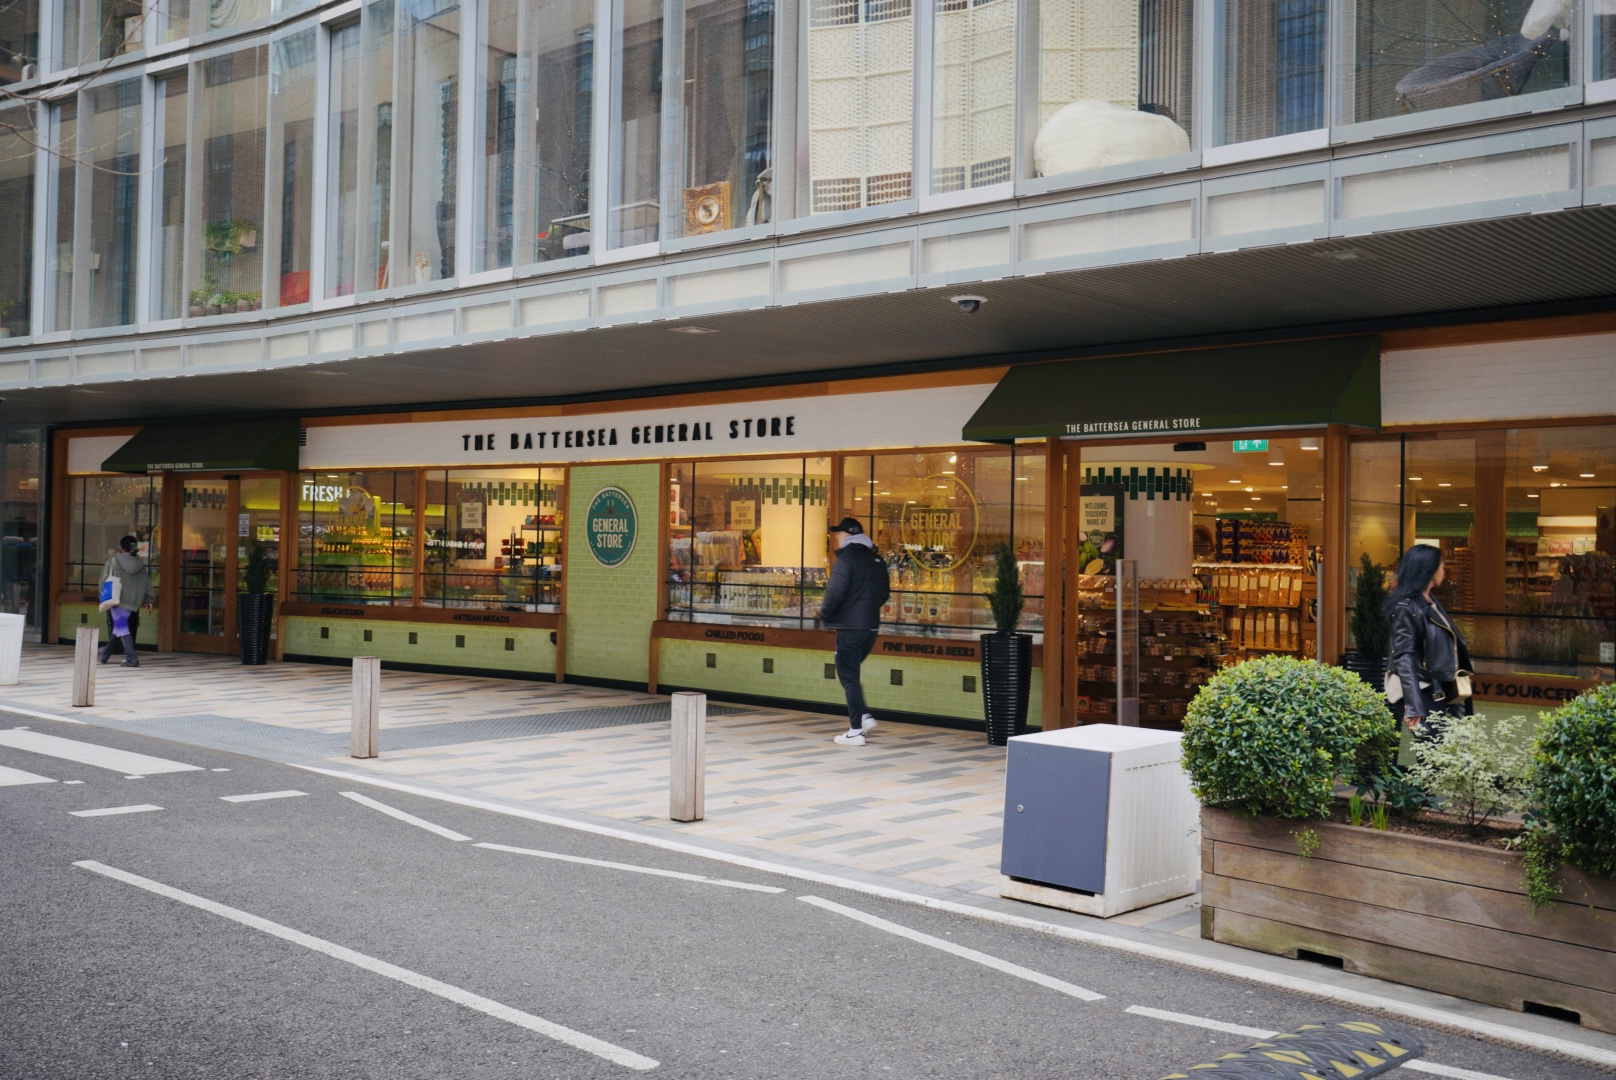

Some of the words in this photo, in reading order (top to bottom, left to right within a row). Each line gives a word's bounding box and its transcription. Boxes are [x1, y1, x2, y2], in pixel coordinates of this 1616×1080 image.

[1066, 424, 1081, 433] THE
[1083, 421, 1129, 433] BATTERSEA
[1131, 419, 1170, 431] GENERAL
[1172, 417, 1201, 429] STORE
[462, 433, 496, 452] THE
[510, 428, 618, 450] BATTERSEA
[631, 421, 713, 445] GENERAL
[729, 416, 796, 439] STORE
[302, 484, 344, 503] FRESH
[592, 497, 601, 510] THE
[601, 491, 630, 510] BATTERSEA
[592, 518, 629, 533] GENERAL
[910, 512, 963, 530] GENERAL
[1086, 518, 1100, 526] MORE
[1100, 518, 1107, 526] AT
[596, 533, 623, 549] STORE
[919, 531, 957, 549] STORE
[321, 607, 365, 617] DELICATESSEN
[452, 613, 482, 622] ARTISAN
[482, 615, 510, 624] BREADS
[705, 629, 736, 640] CHILLED
[737, 631, 766, 642] FOODS
[882, 641, 904, 652] FINE
[904, 643, 935, 655] WINES
[936, 645, 944, 656] &
[944, 646, 976, 657] BEERS
[1495, 683, 1580, 701] SOURCED
